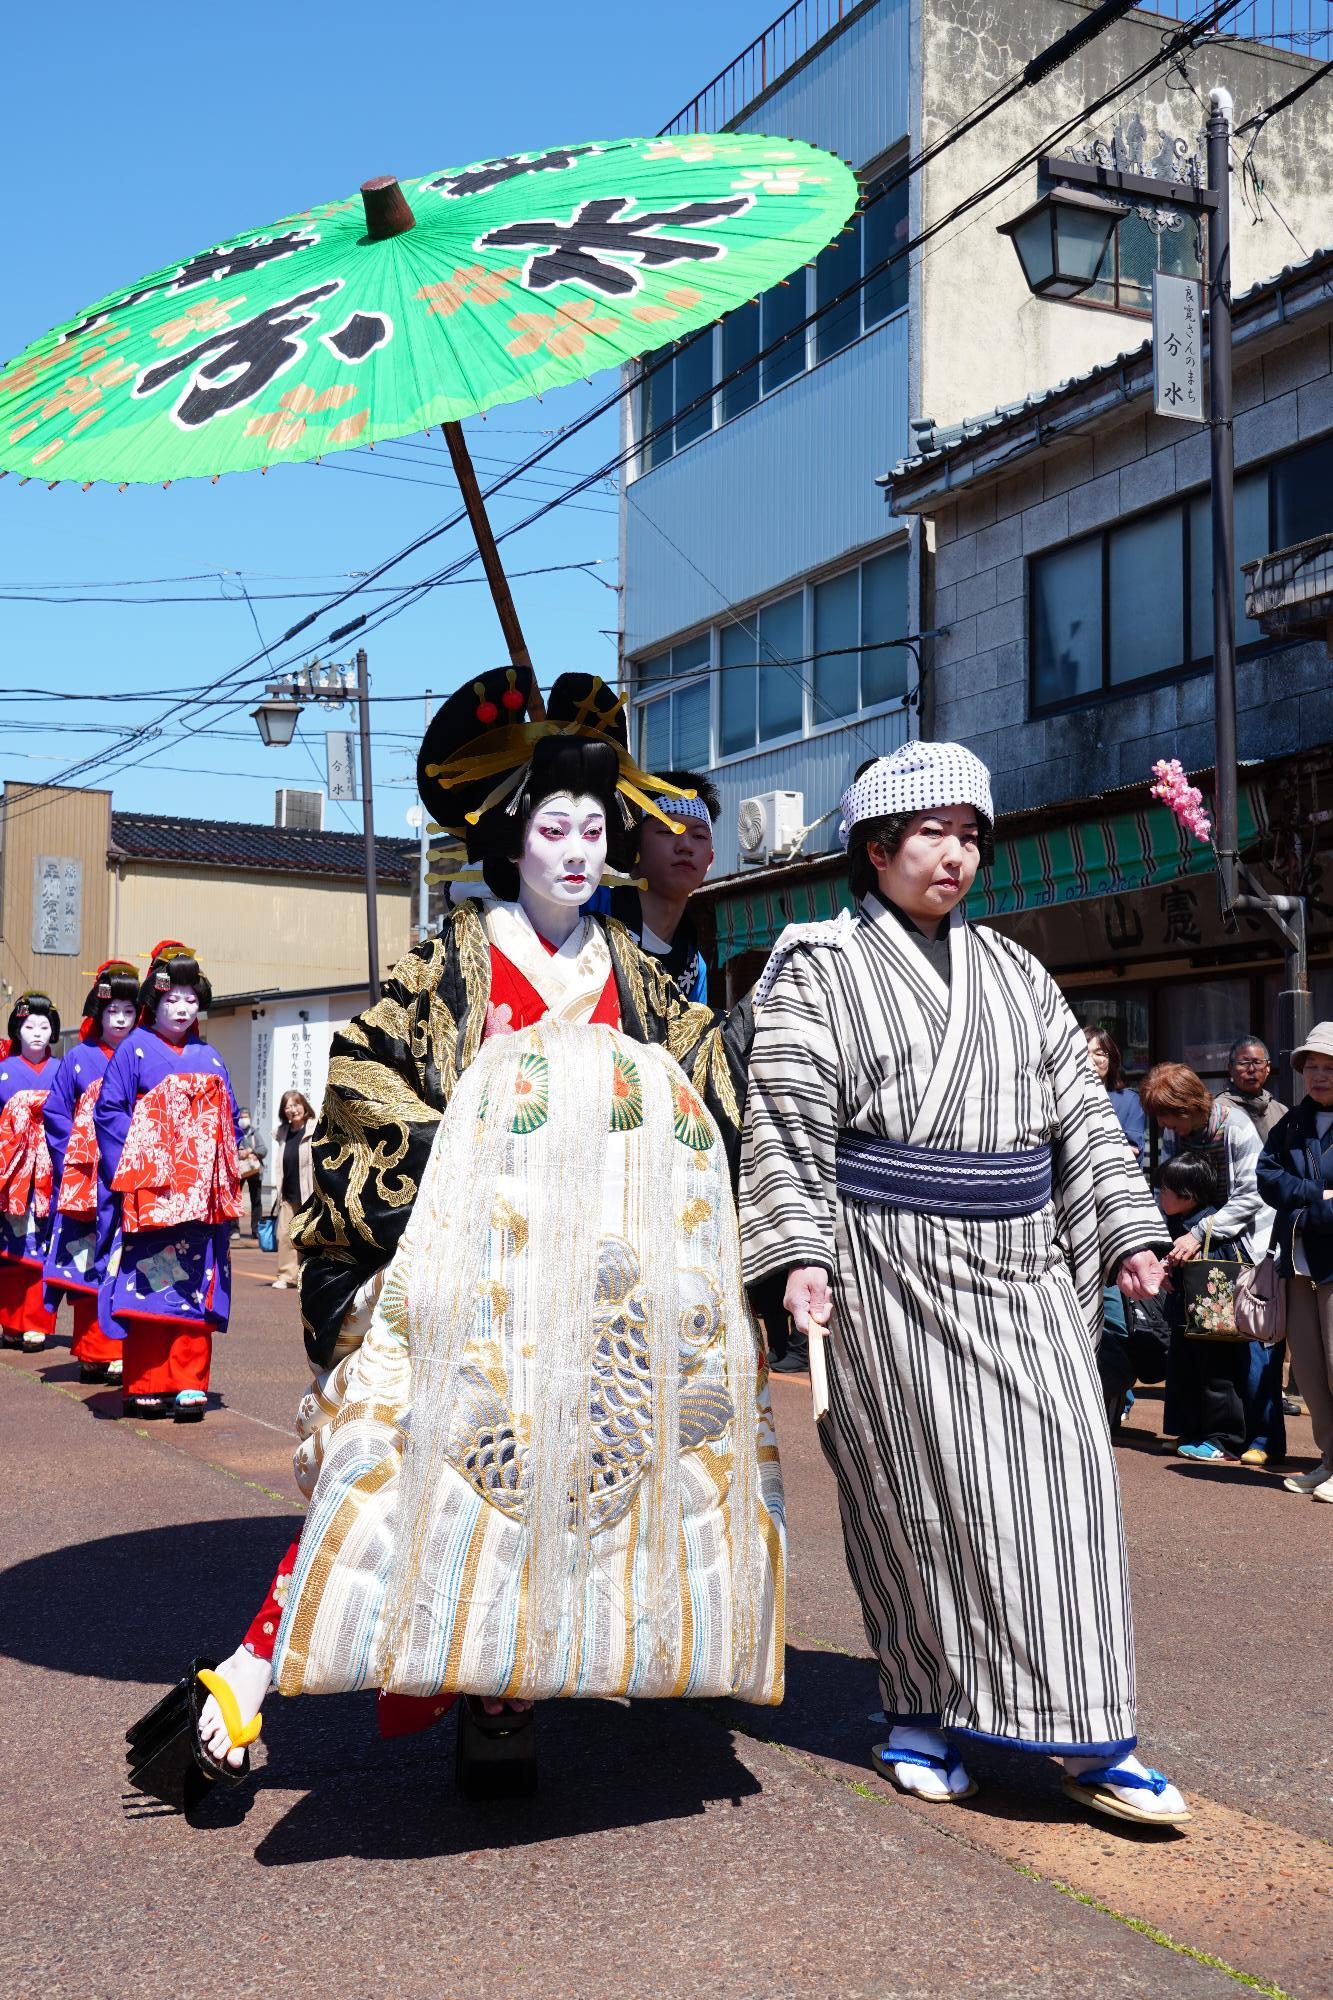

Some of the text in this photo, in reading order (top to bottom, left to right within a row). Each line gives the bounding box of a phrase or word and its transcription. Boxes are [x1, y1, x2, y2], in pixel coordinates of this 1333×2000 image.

[1163, 332, 1184, 406] 分水
[1184, 285, 1196, 404] 良寛さんのまち
[332, 760, 344, 796] 分水
